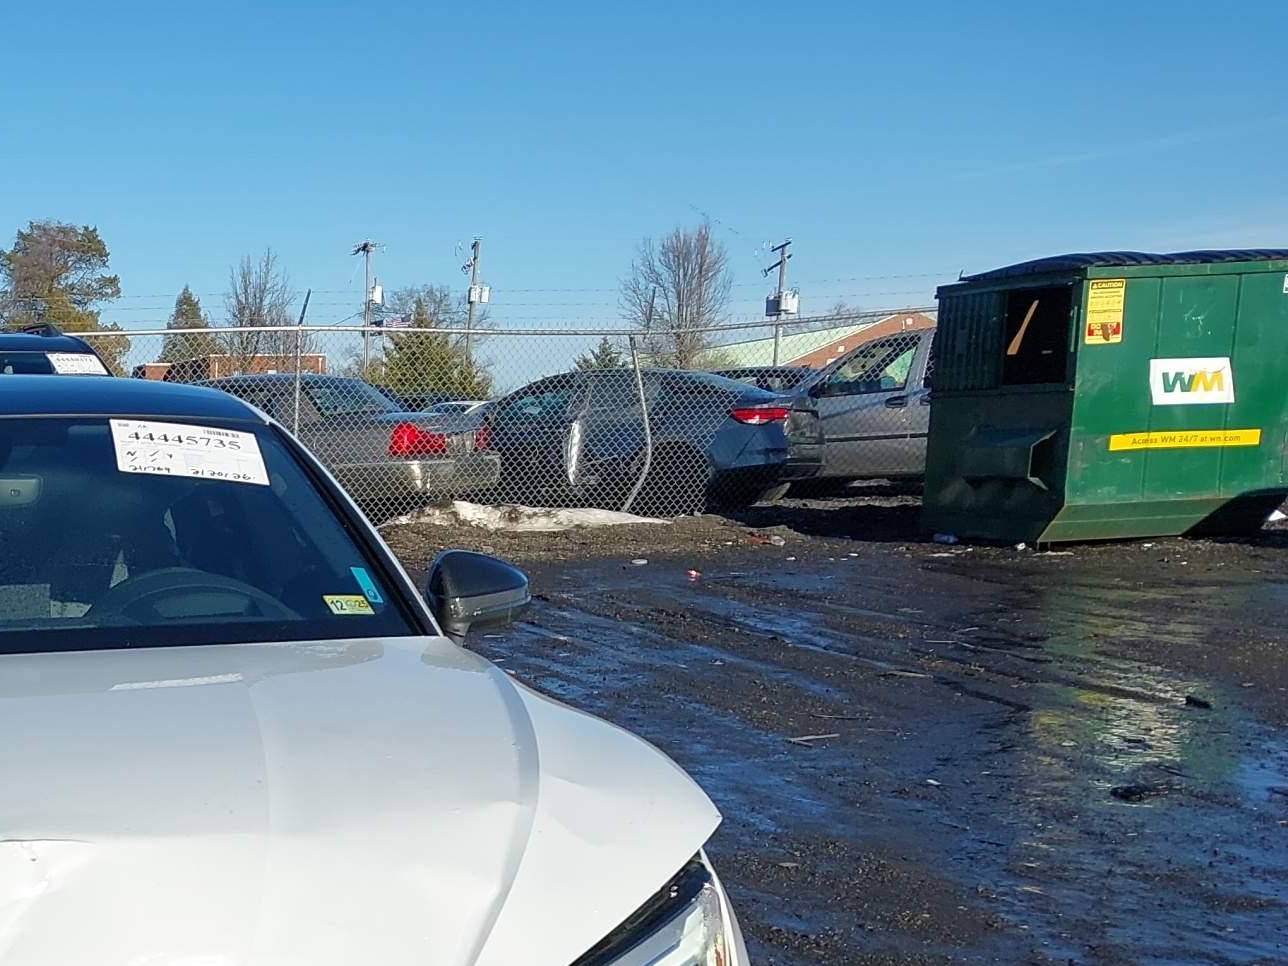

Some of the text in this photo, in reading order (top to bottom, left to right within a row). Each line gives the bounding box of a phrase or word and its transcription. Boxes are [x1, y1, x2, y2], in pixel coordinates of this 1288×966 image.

[1162, 371, 1224, 393] WM
[128, 431, 241, 450] 44445735
[1160, 435, 1176, 443] WM
[1177, 434, 1199, 443] 24/7
[330, 600, 347, 611] 12
